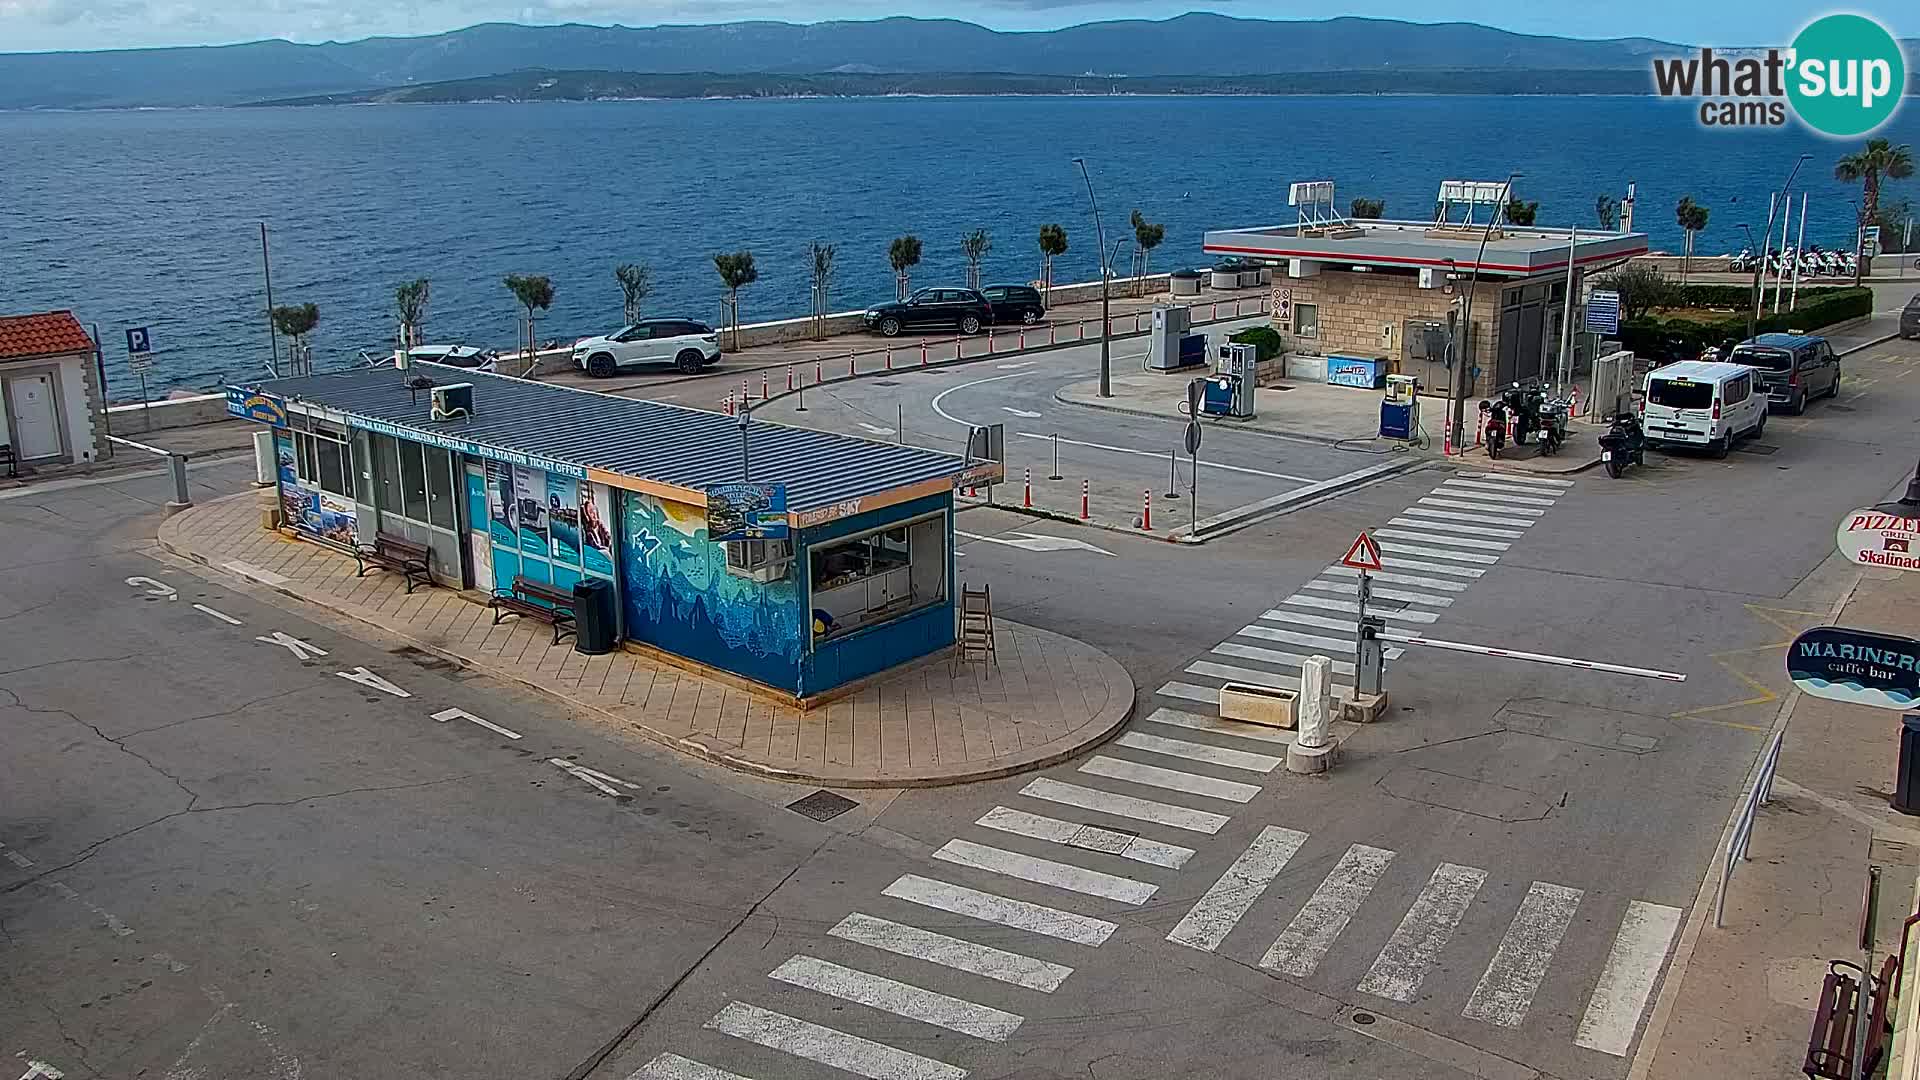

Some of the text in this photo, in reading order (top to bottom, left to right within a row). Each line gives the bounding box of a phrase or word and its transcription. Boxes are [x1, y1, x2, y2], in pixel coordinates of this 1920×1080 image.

[131, 331, 144, 350] P
[397, 427, 437, 444] AUTOBUSNA
[437, 436, 469, 452] POSTAJA
[478, 446, 583, 477] BUS STATION TICKET OFFICE
[1847, 514, 1920, 534] PIZZE
[1880, 530, 1917, 541] GRILL
[1828, 662, 1896, 680] caffe bar
